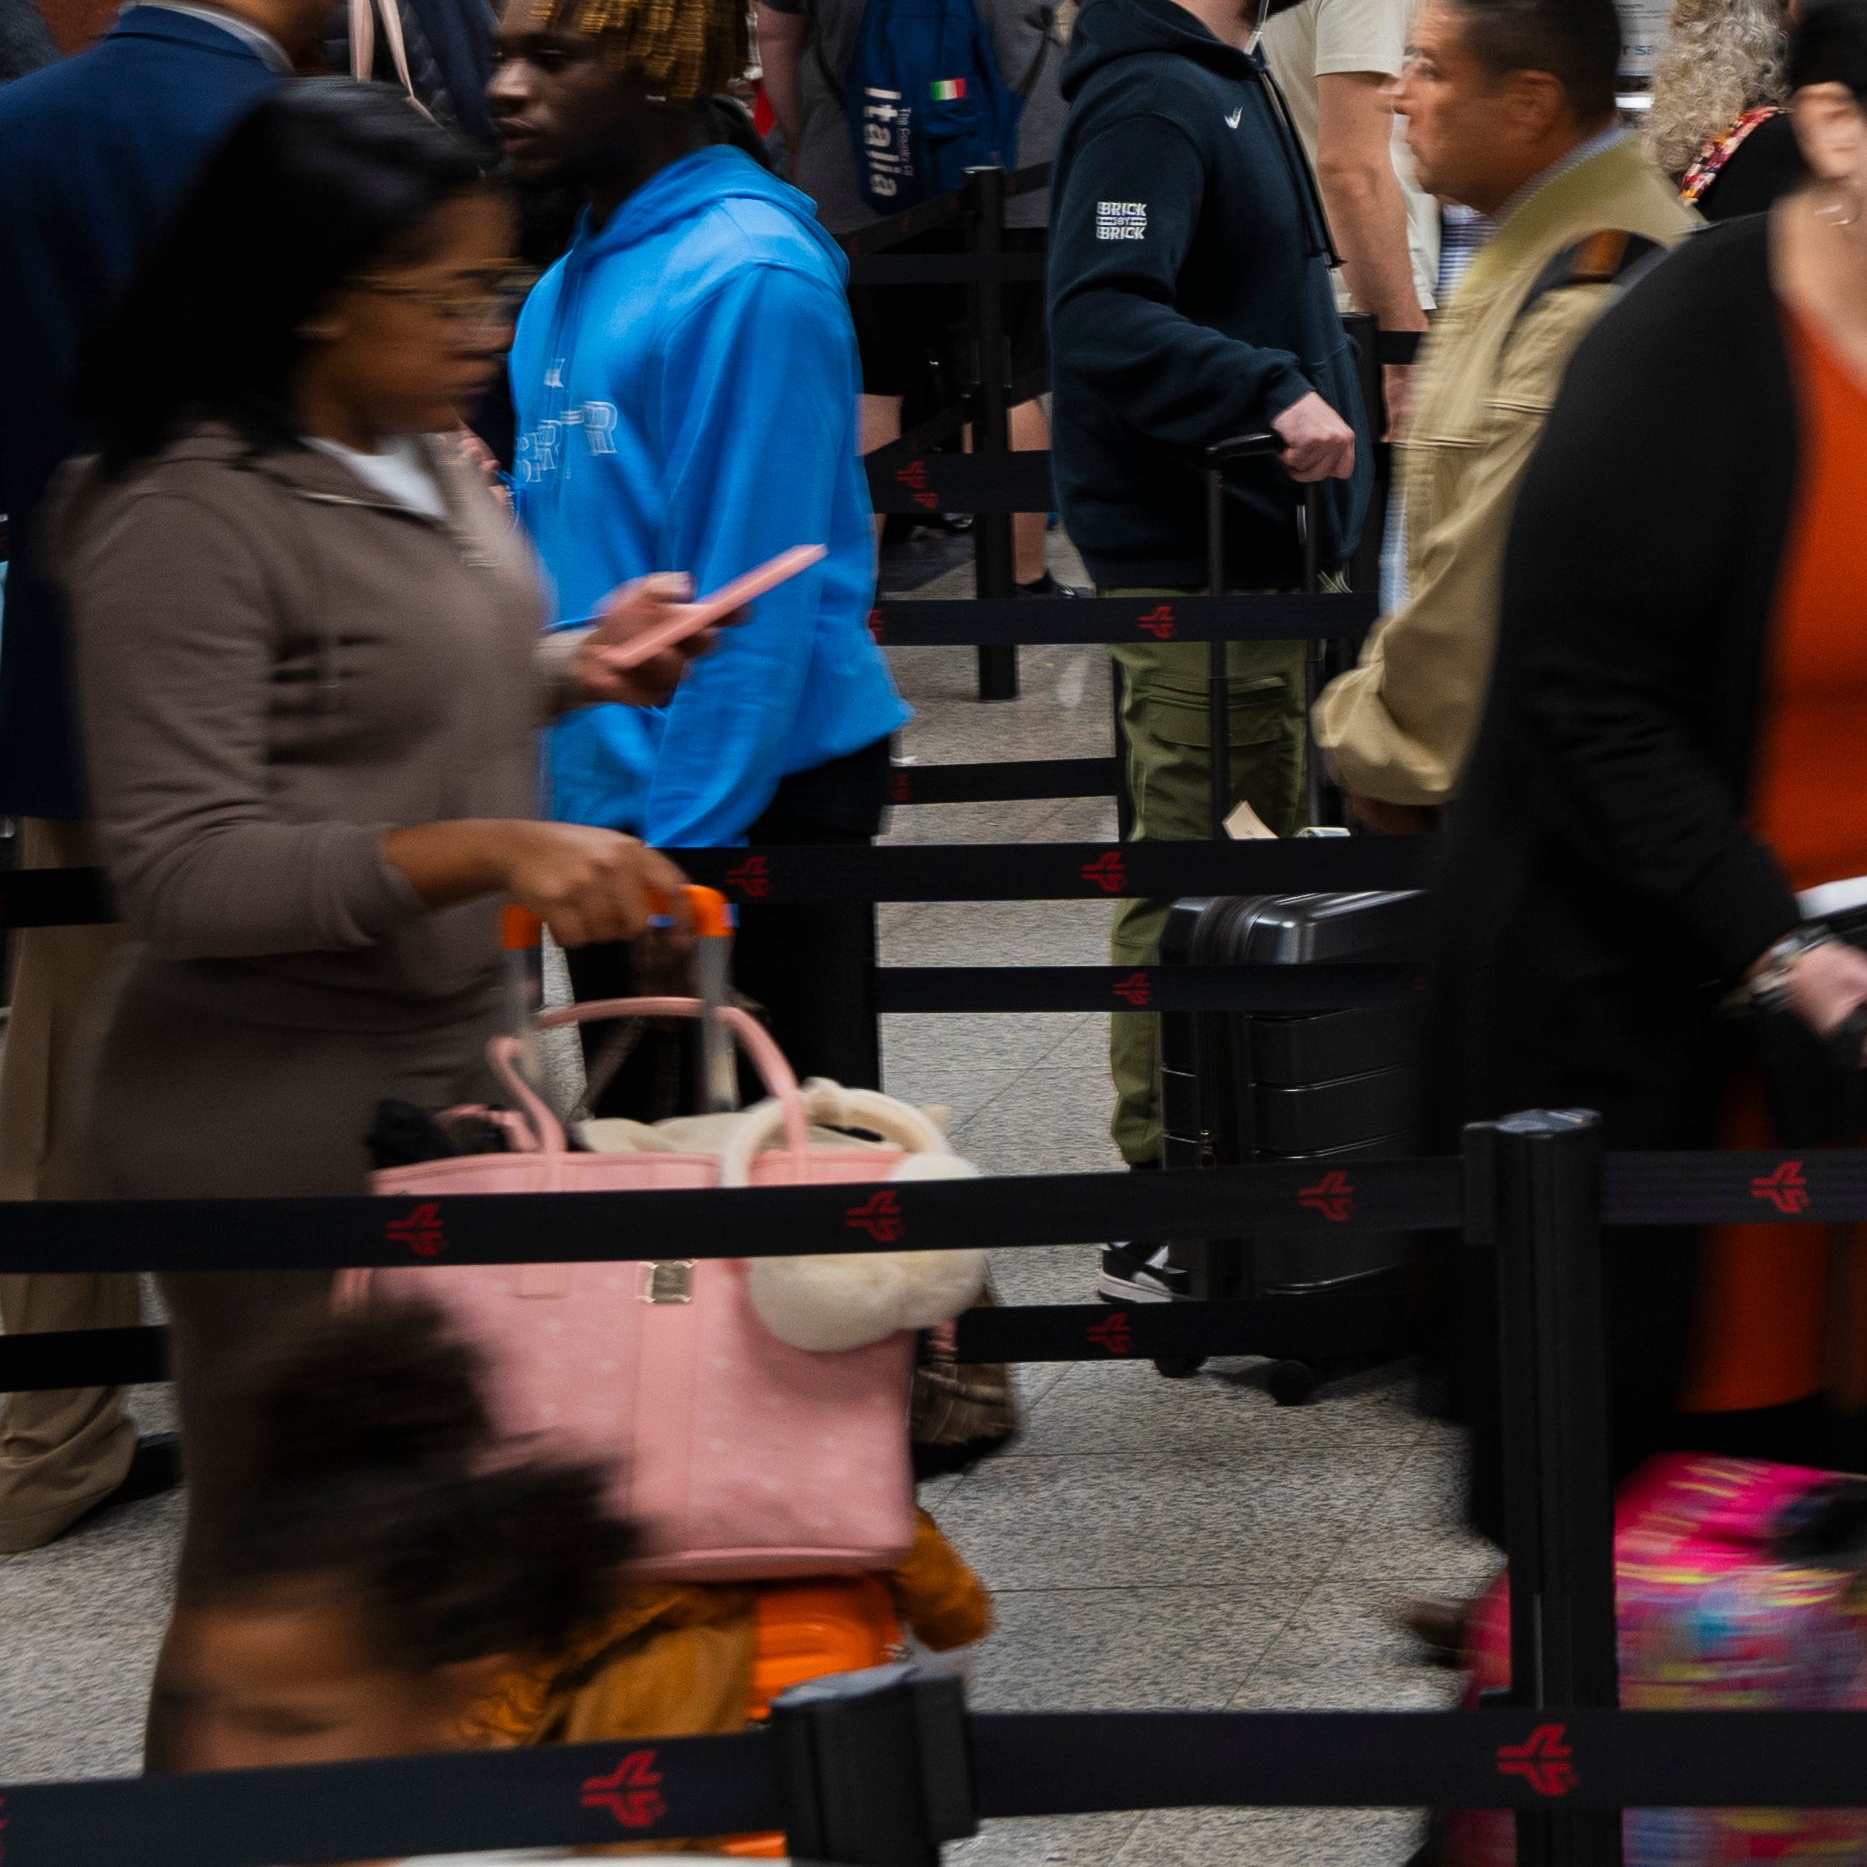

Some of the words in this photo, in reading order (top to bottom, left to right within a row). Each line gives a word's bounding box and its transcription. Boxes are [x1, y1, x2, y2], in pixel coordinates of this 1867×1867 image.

[863, 87, 902, 197] Italia
[1097, 201, 1147, 216] BRICK
[1116, 217, 1130, 225] BY
[1096, 226, 1146, 240] BRICK
